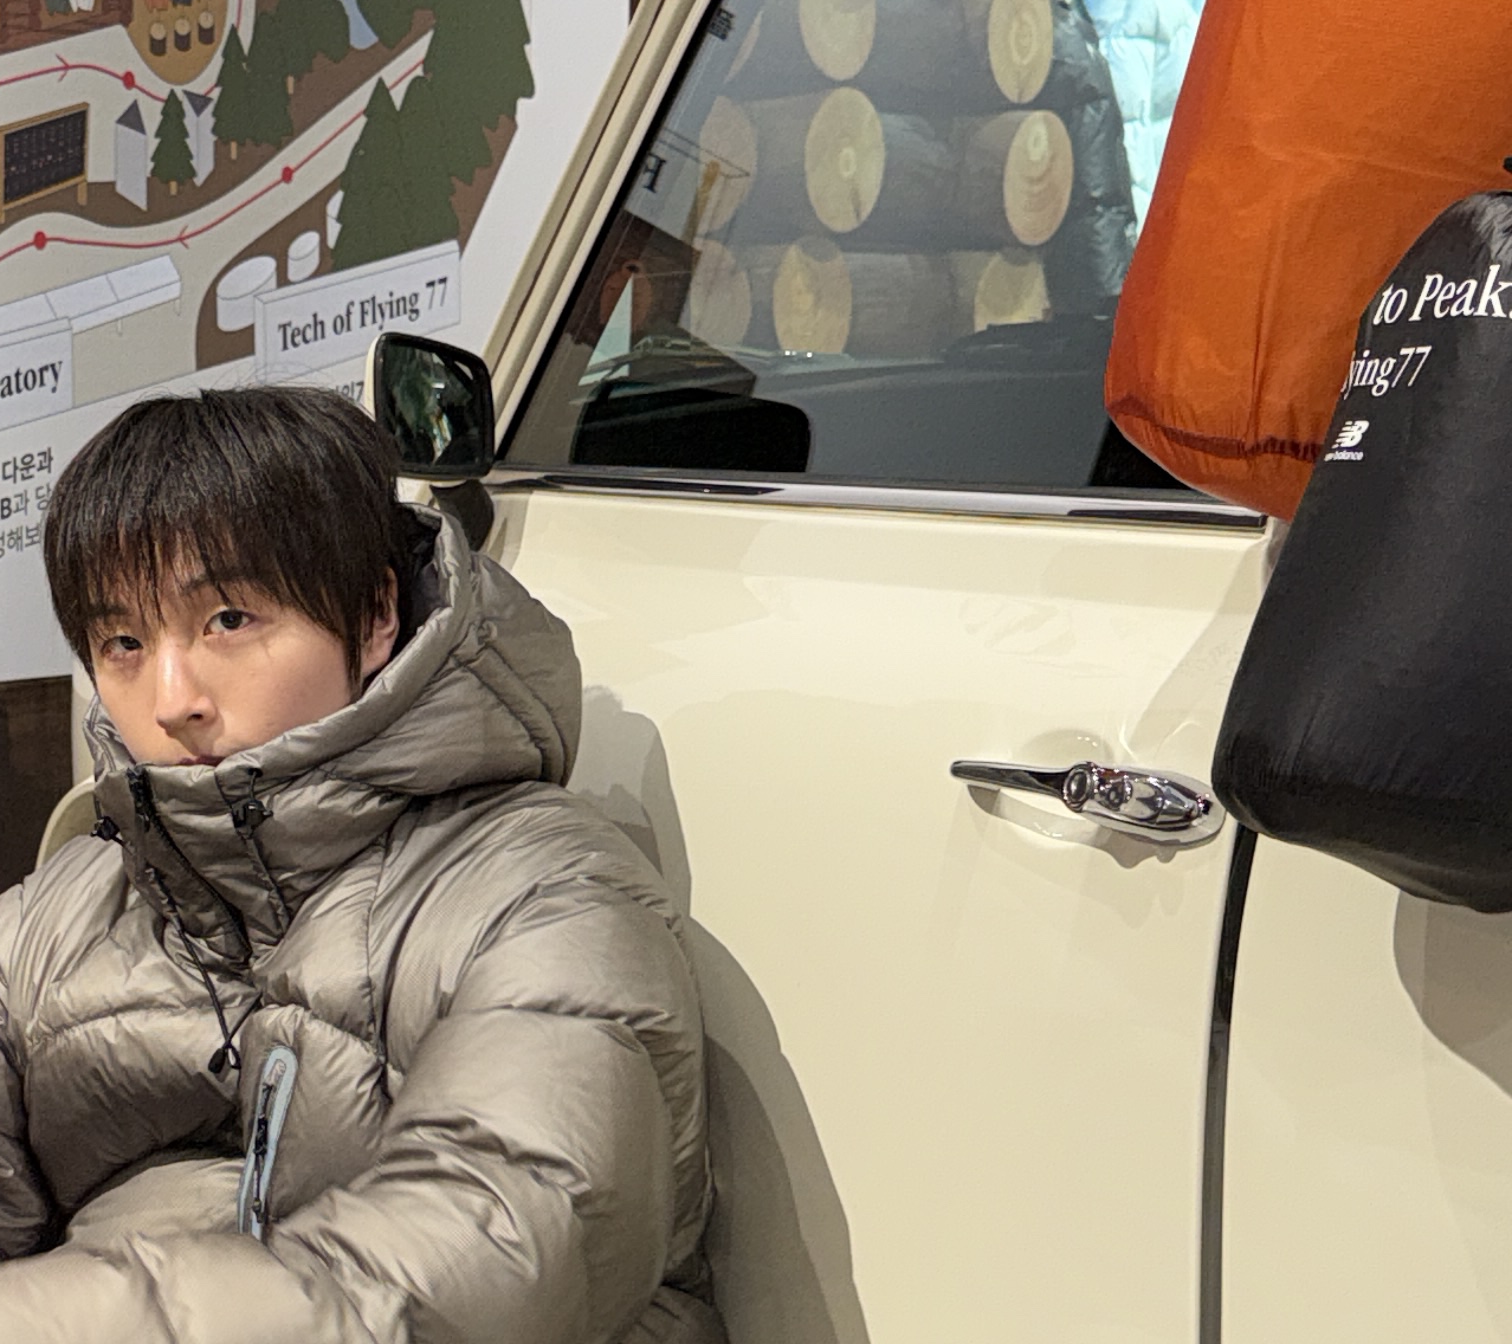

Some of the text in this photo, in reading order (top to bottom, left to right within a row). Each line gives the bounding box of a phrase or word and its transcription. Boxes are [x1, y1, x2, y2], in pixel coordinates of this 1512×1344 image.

[278, 276, 448, 352] Tech of Flying 77
[1373, 264, 1512, 325] to Peak
[1340, 345, 1432, 400] ying77
[1, 447, 54, 485] 다운과
